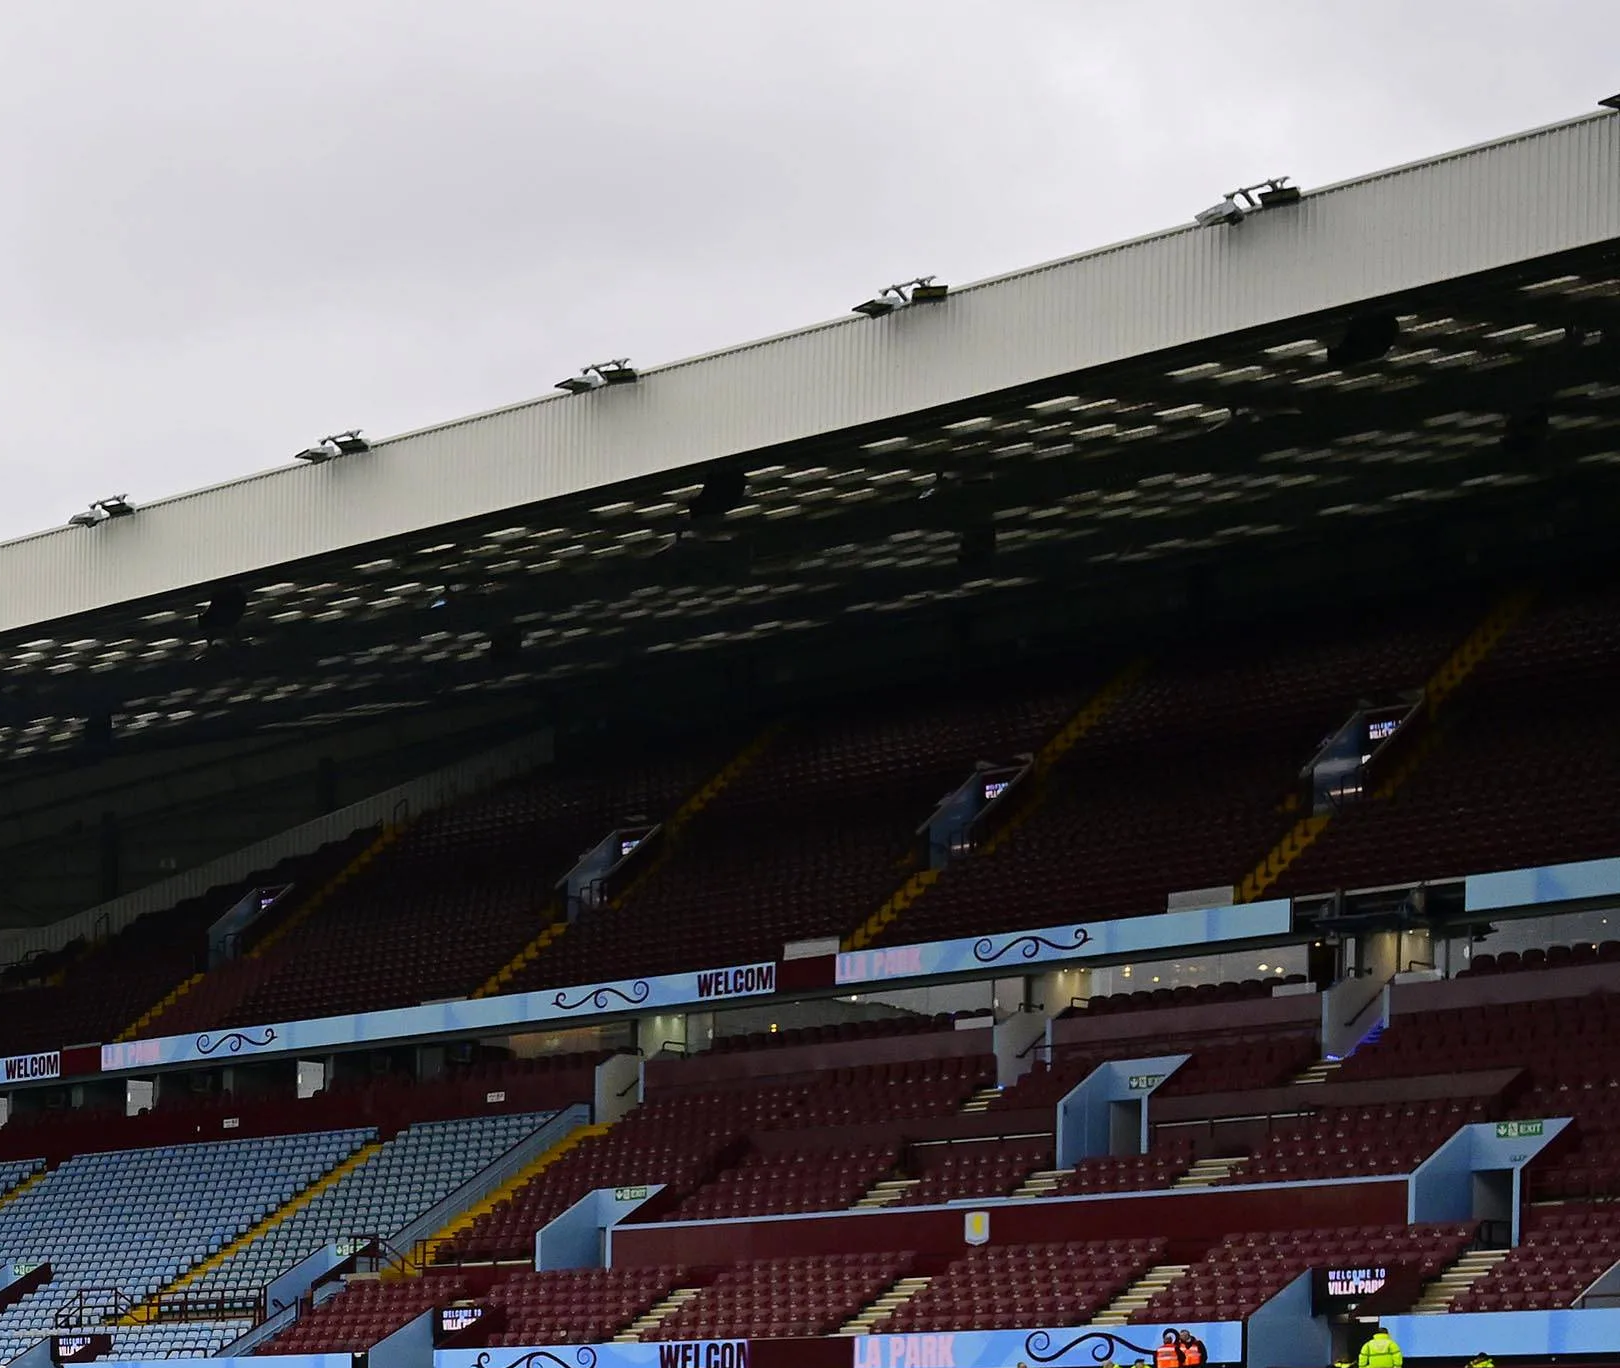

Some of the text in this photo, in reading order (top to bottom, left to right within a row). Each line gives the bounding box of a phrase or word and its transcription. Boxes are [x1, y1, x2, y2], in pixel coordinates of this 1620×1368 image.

[697, 965, 774, 998] WELCOM
[5, 1054, 59, 1080] WELCOM
[1328, 1266, 1386, 1281] WELCOME TO
[1328, 1280, 1357, 1296] VILLA
[889, 1334, 956, 1368] PARK
